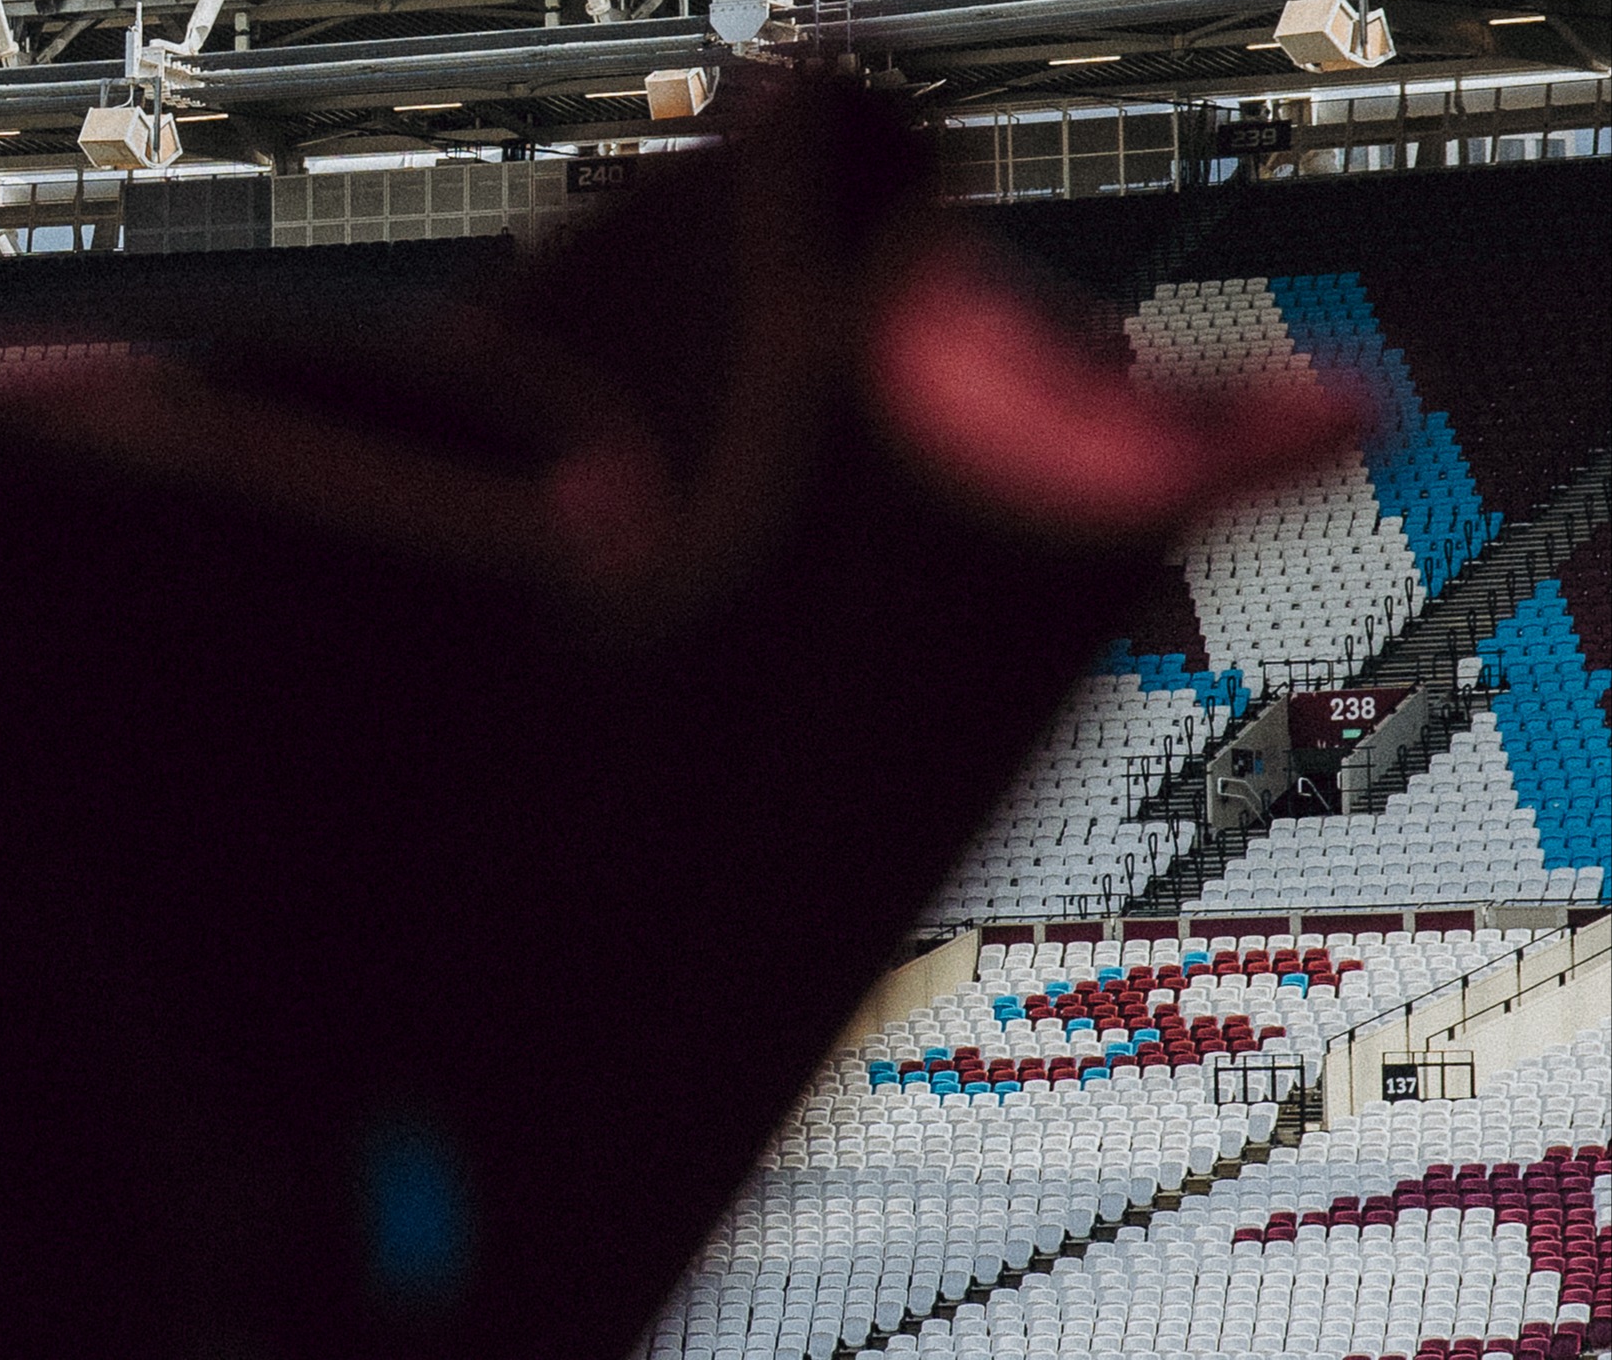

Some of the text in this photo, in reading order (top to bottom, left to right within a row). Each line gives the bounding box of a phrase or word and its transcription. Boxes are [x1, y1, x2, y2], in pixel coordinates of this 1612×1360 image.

[1232, 128, 1277, 147] 239
[578, 165, 624, 186] 240
[1330, 697, 1376, 721] 238
[1386, 1077, 1417, 1094] 137
